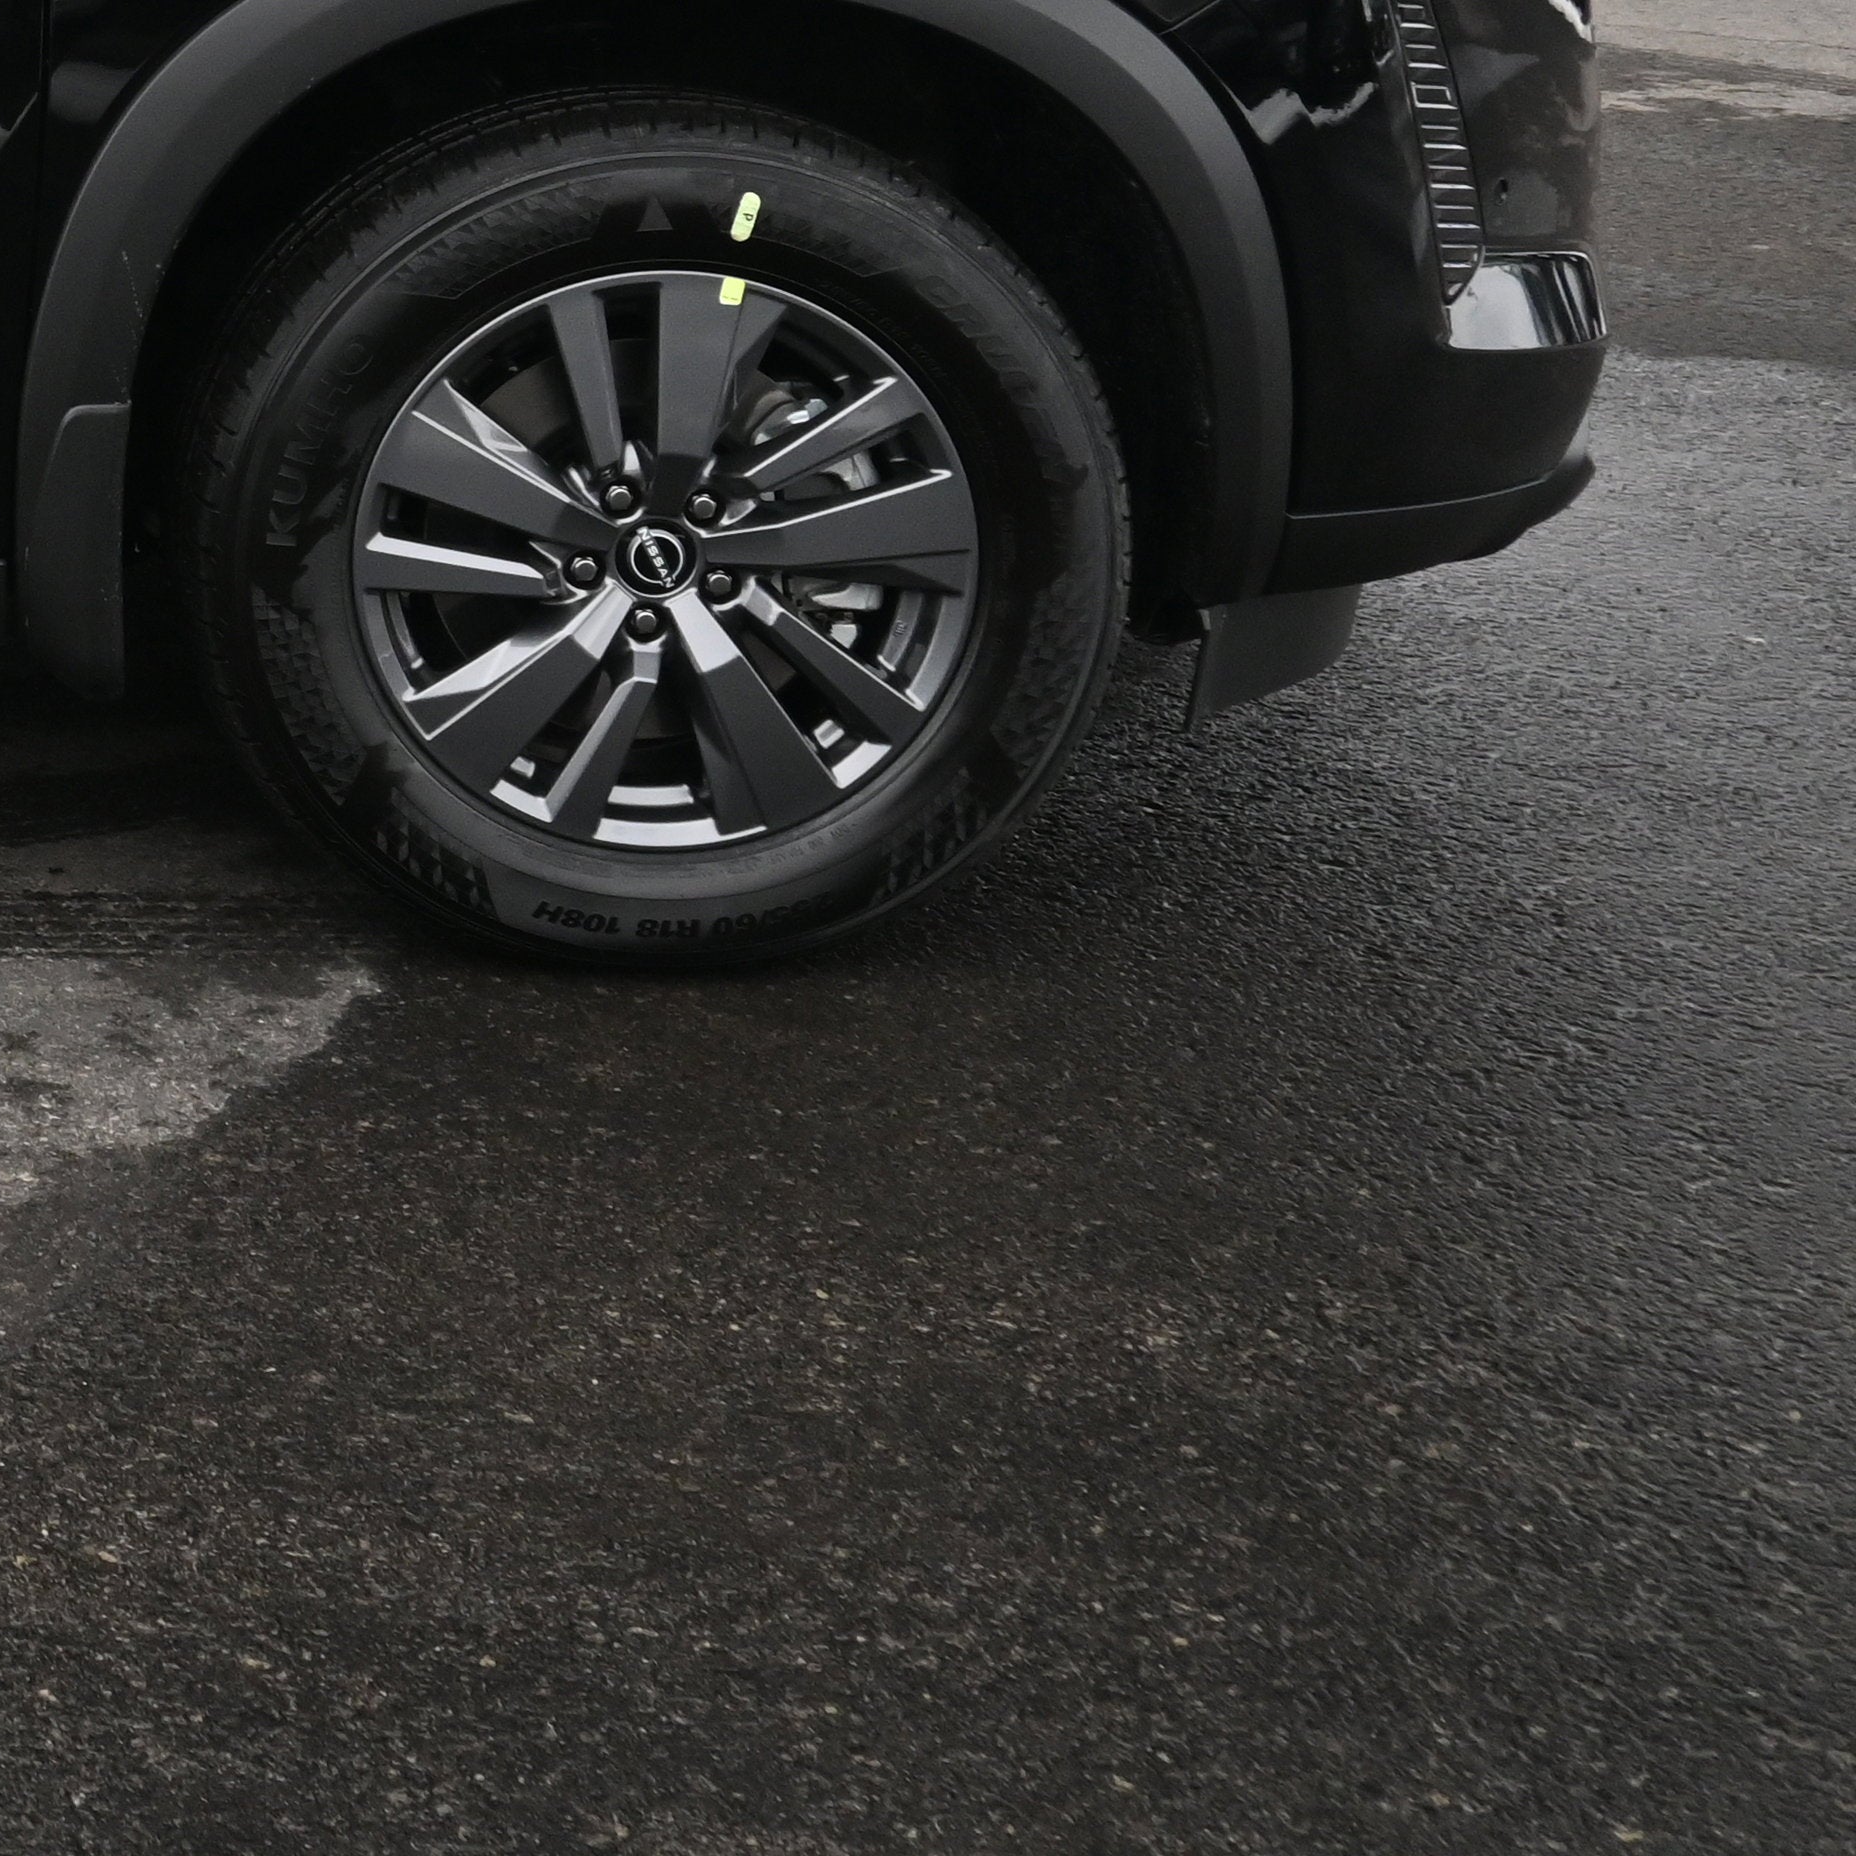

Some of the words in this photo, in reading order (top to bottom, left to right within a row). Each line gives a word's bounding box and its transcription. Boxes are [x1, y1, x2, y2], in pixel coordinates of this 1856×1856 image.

[265, 334, 374, 547] KUMHO
[635, 526, 676, 588] NISSAN
[531, 900, 621, 935] 108H
[635, 917, 702, 939] R18
